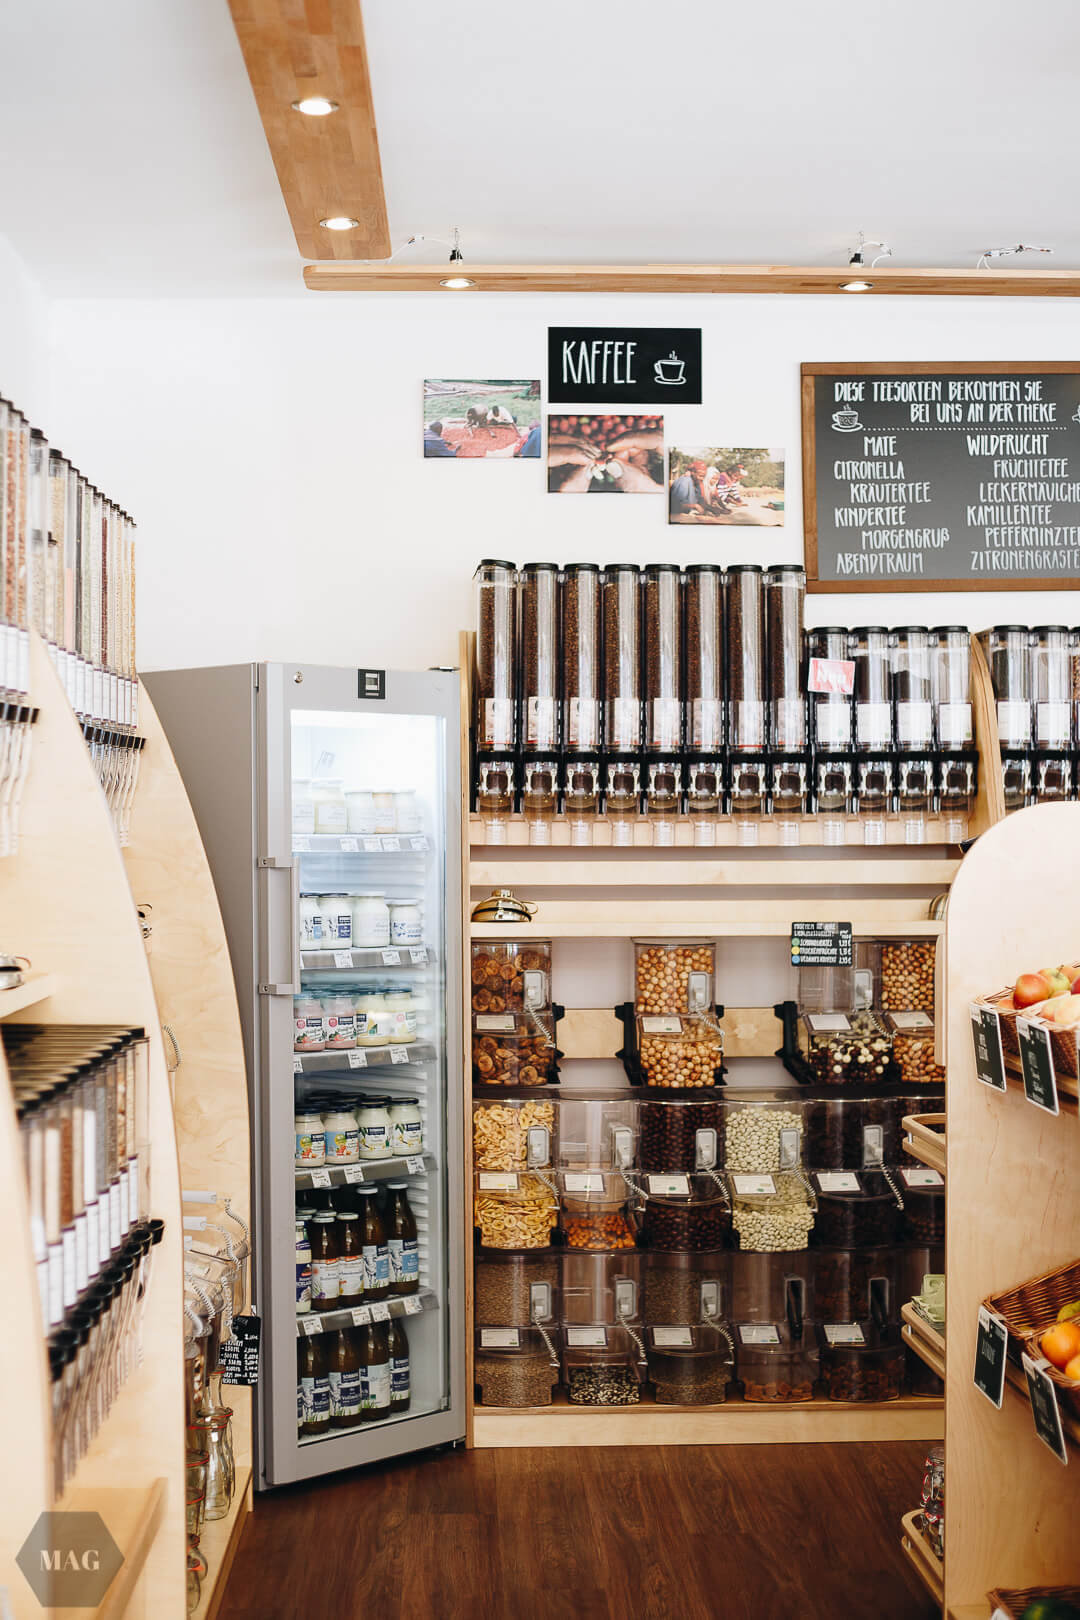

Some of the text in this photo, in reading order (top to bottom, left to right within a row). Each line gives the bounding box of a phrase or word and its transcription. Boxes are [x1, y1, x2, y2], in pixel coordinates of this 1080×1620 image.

[562, 340, 638, 384] KAFFEE
[834, 380, 1043, 402] DIESE TEESORTEN BEKOMMEN SIE
[910, 403, 1057, 423] BEI UNS AN DER THEKE
[863, 435, 897, 457] MATE
[966, 434, 1049, 456] WILDFRUCHT
[833, 460, 905, 480] CITRONELLA
[993, 458, 1070, 478] FRÜCHTETEE
[849, 481, 932, 503] KRÄUTERTEE
[834, 505, 906, 528] KINDERTEE
[966, 504, 1053, 526] KAMILLENTEE
[836, 552, 923, 574] ABENDTRAUM
